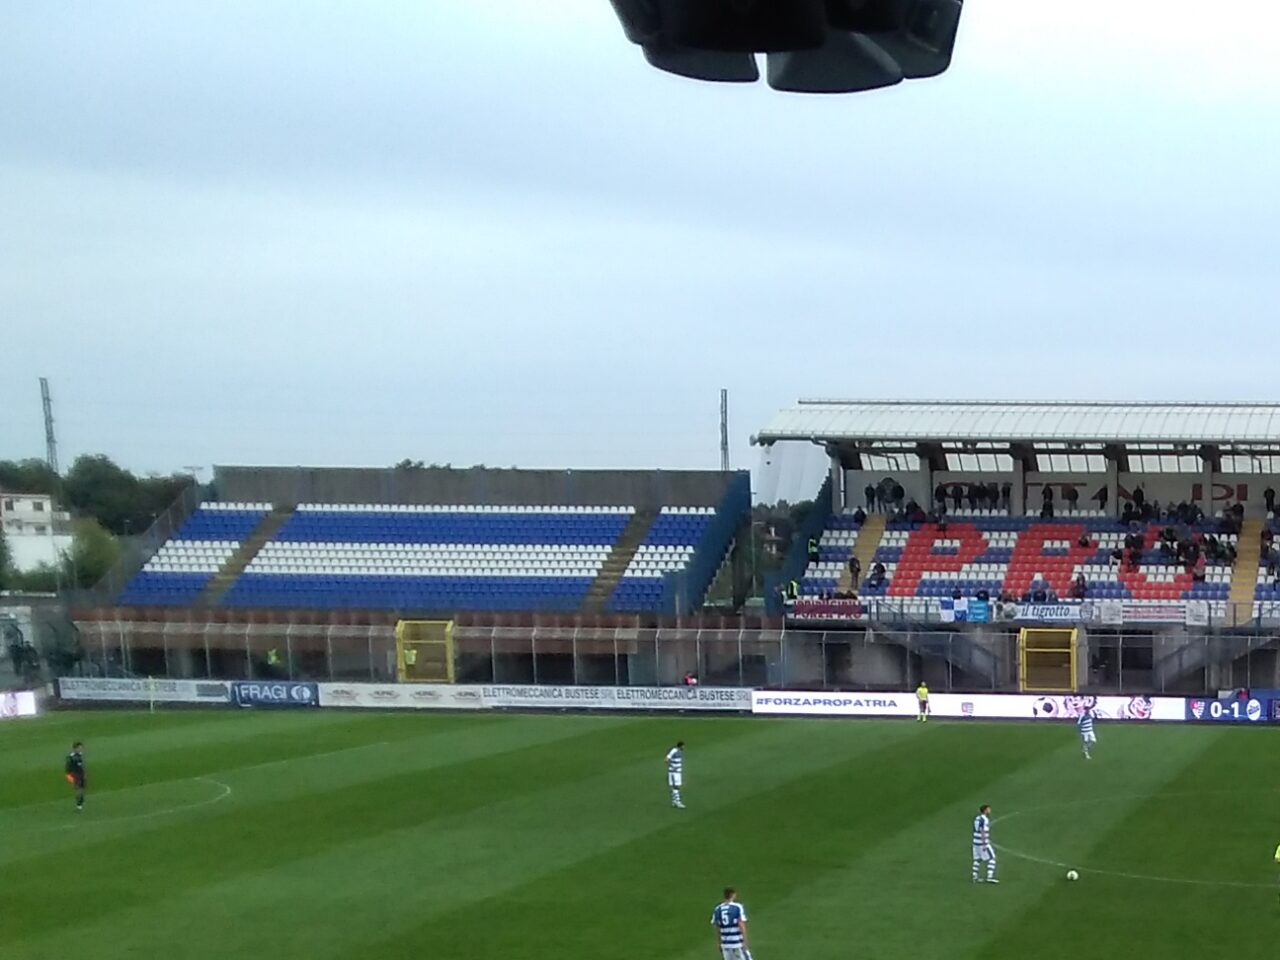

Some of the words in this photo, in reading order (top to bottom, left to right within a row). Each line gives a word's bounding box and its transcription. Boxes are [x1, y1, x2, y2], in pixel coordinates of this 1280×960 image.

[241, 685, 287, 699] FRAGI
[483, 687, 562, 699] ELETTROMECCANICA
[564, 688, 599, 699] BUSTESE
[617, 690, 697, 700] ELETTROMECCANICA
[699, 691, 735, 701] BUSTESE
[756, 698, 897, 707] #FORZAPROPATRIA
[721, 910, 729, 925] 5
